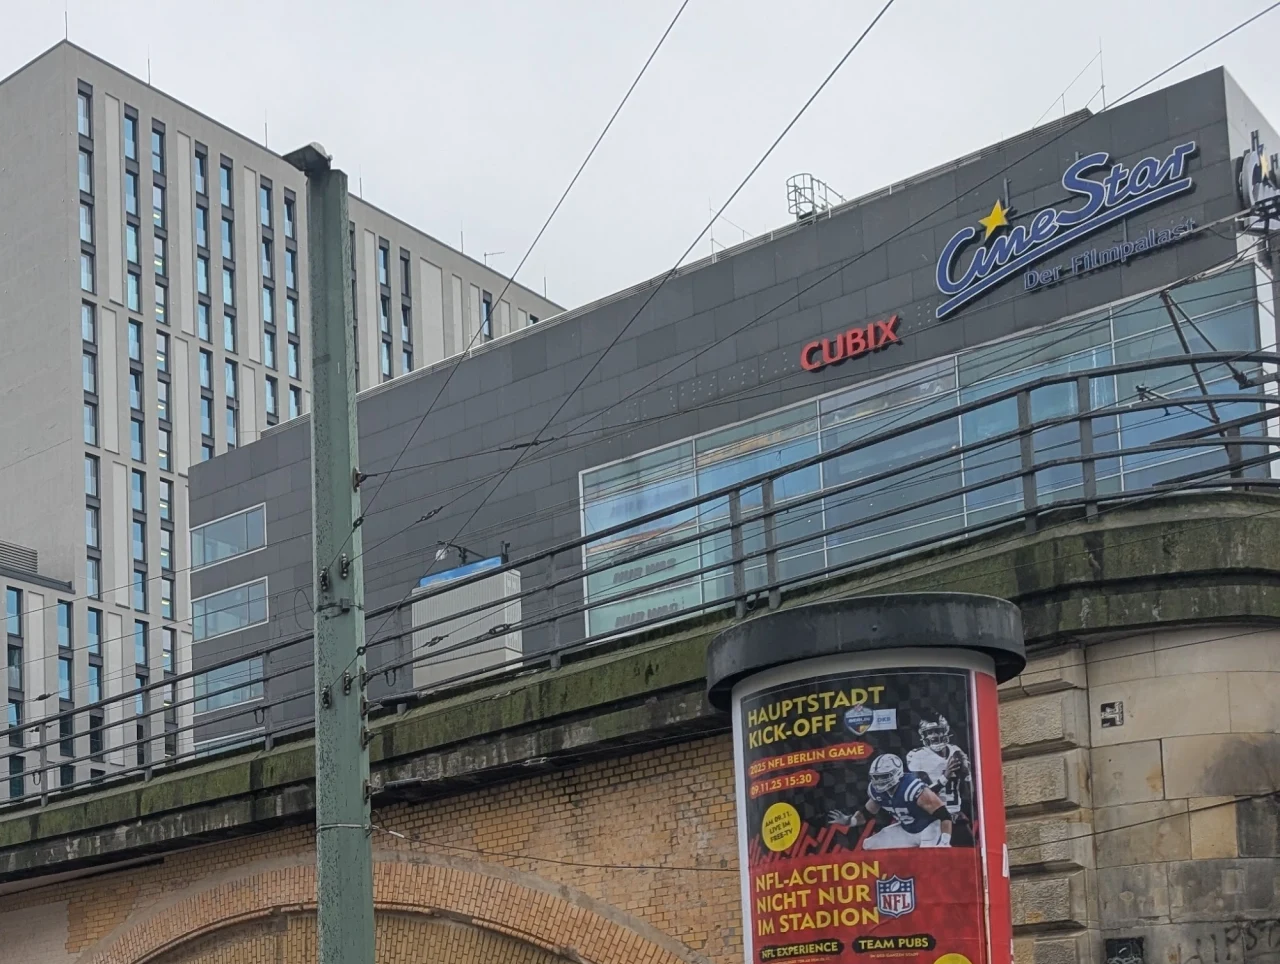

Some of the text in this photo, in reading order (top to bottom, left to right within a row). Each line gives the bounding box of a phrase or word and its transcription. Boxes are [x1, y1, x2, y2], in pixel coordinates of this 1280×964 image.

[936, 141, 1195, 295] CineStar
[1024, 218, 1196, 290] Der Filmpalast
[800, 315, 899, 371] CUBIX
[748, 686, 885, 728] HAUPTSTADT
[749, 714, 837, 749] KICK-OFF
[750, 746, 864, 775] 2025 NFL BERLIN GAME
[751, 774, 812, 796] 09.11.25 15:30
[765, 818, 774, 827] AM
[769, 825, 781, 833] LIVE
[770, 828, 793, 843] FREE-TV
[756, 860, 887, 892] NFL-ACTION,
[757, 885, 871, 915] NICHT NUR
[882, 892, 910, 910] NFL
[758, 907, 880, 936] IM STADION
[762, 942, 838, 959] NFL EXPERIENCE
[859, 937, 929, 950] TEAM PUBS
